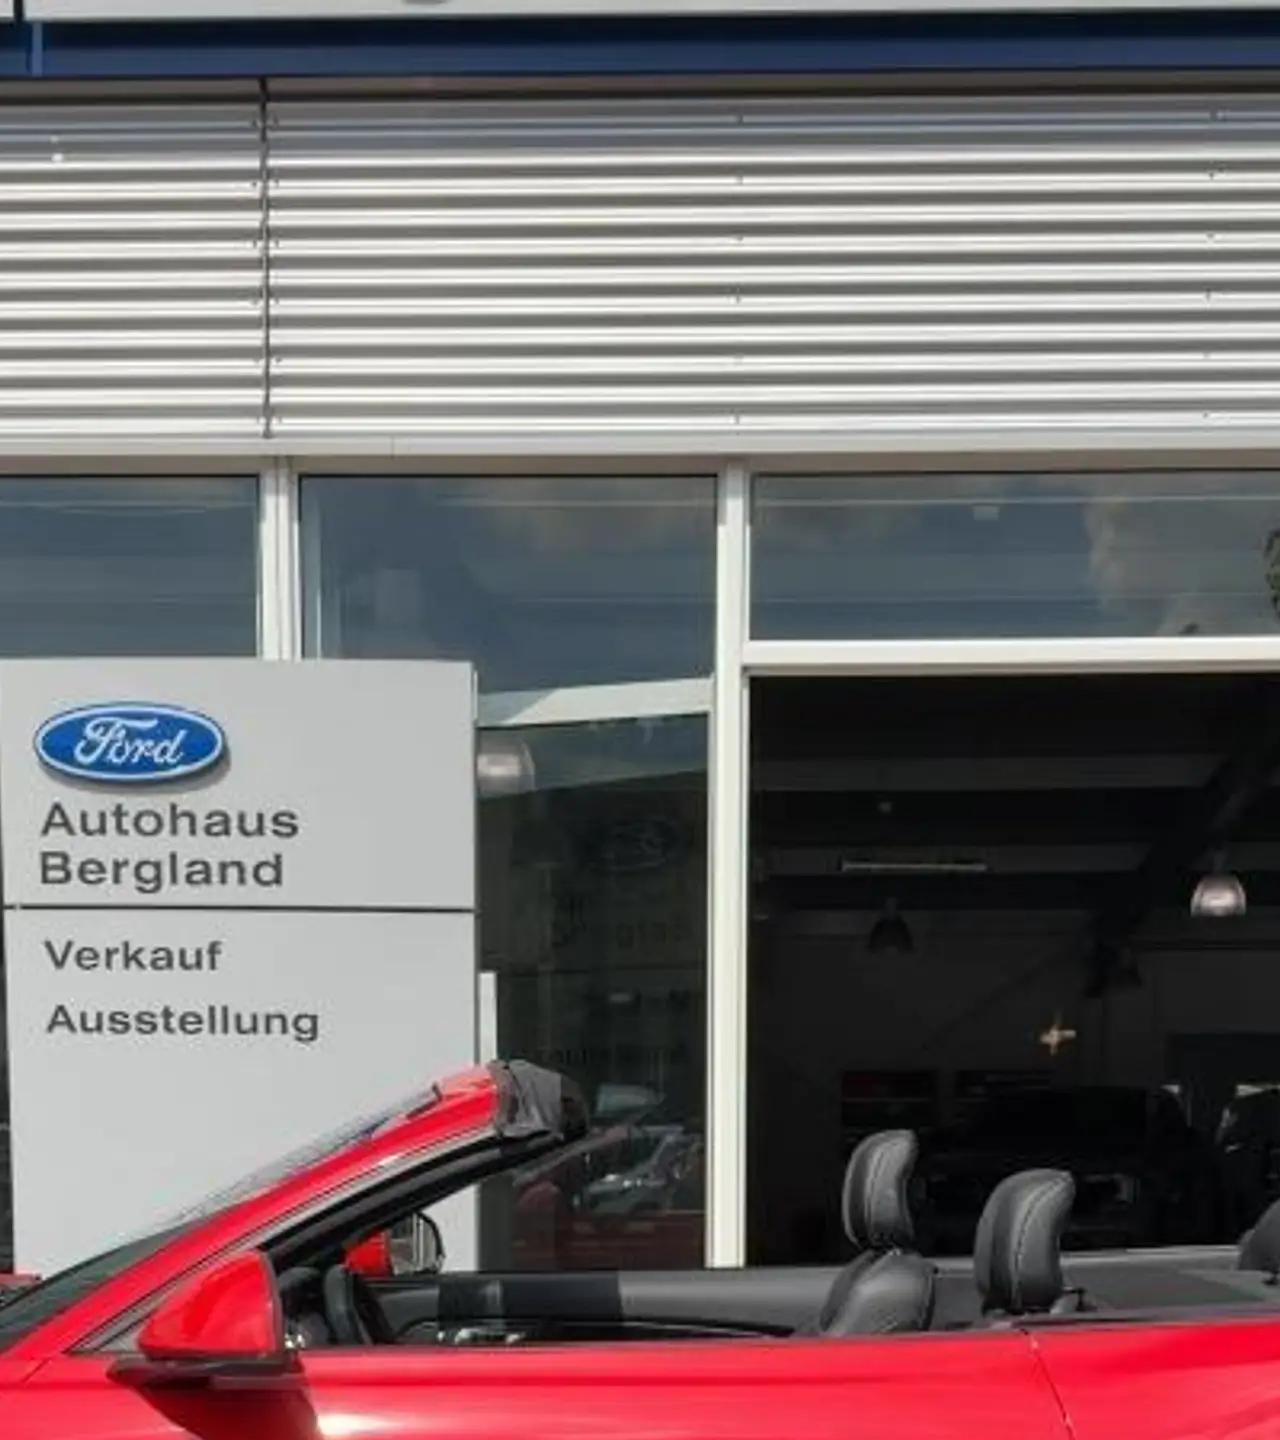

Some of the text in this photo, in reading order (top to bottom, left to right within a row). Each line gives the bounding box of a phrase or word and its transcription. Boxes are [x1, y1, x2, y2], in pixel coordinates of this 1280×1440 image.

[74, 716, 187, 766] Ford
[40, 802, 300, 839] Autohaus
[40, 850, 283, 894] Bergland
[44, 939, 222, 972] Verkauf
[46, 1004, 320, 1043] Ausstellung
